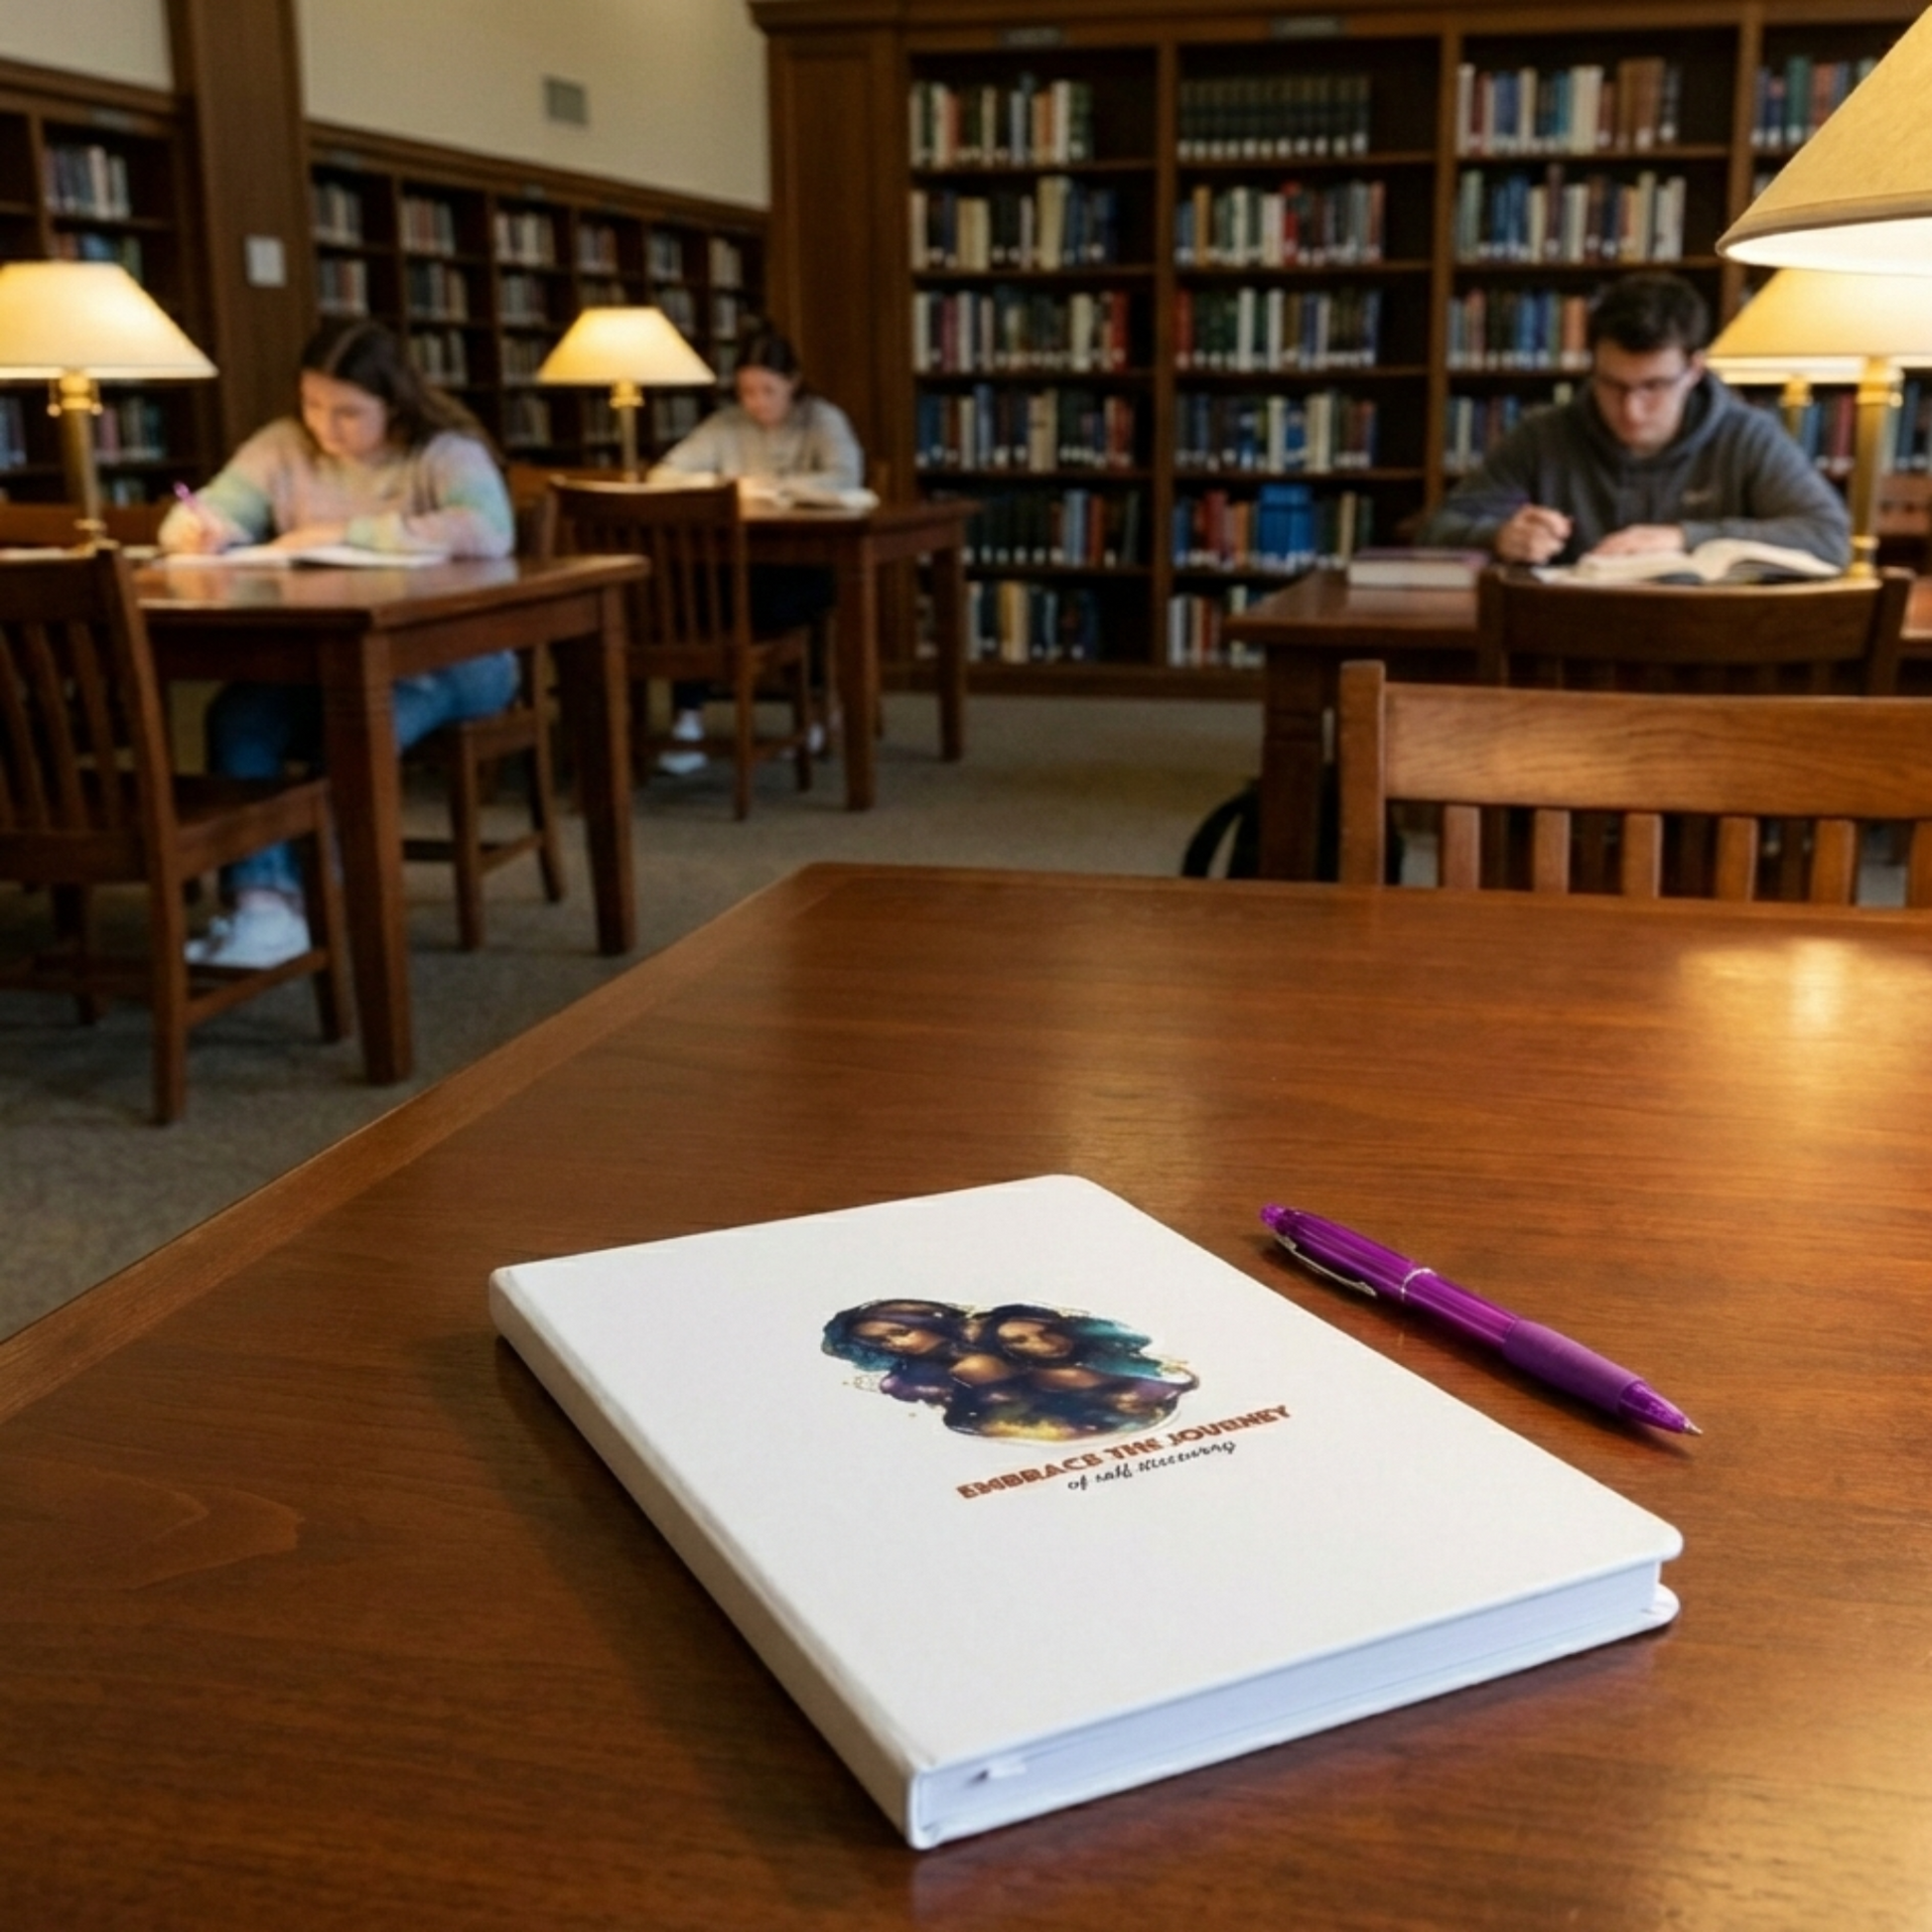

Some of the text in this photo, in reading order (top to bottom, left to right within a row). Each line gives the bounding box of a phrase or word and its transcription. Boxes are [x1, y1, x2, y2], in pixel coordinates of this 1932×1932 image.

[957, 1453, 1103, 1498] EMBRACE
[1167, 1405, 1290, 1447] JOURNEY
[1067, 1474, 1088, 1491] of
